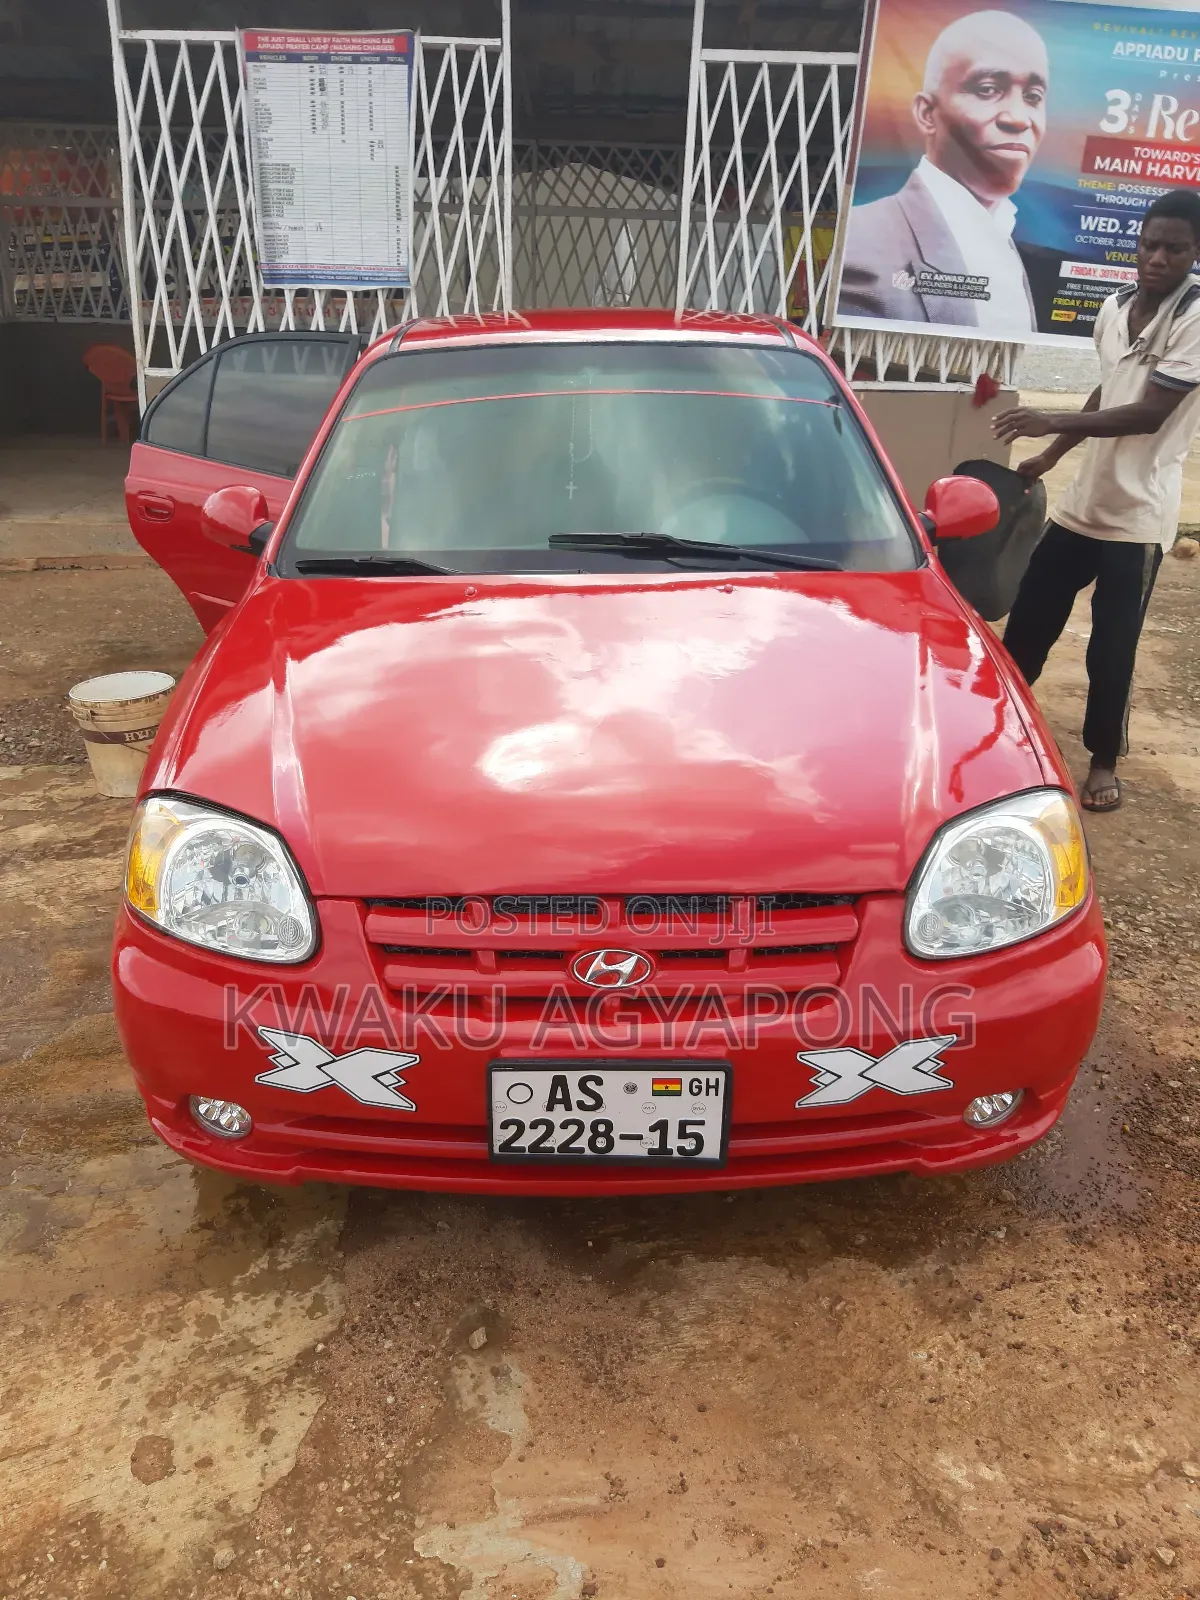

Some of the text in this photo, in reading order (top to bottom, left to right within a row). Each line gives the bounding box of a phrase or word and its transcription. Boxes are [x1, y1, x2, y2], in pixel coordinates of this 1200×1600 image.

[1113, 42, 1188, 60] APPIADU
[1100, 89, 1131, 133] 3
[1094, 156, 1142, 174] MAIN
[1078, 179, 1116, 191] THEME:
[1095, 193, 1146, 207] THROUGH
[1081, 215, 1123, 234] WED.
[546, 1074, 604, 1112] AS
[689, 1078, 719, 1096] GH
[499, 1118, 706, 1156] 2228-15
